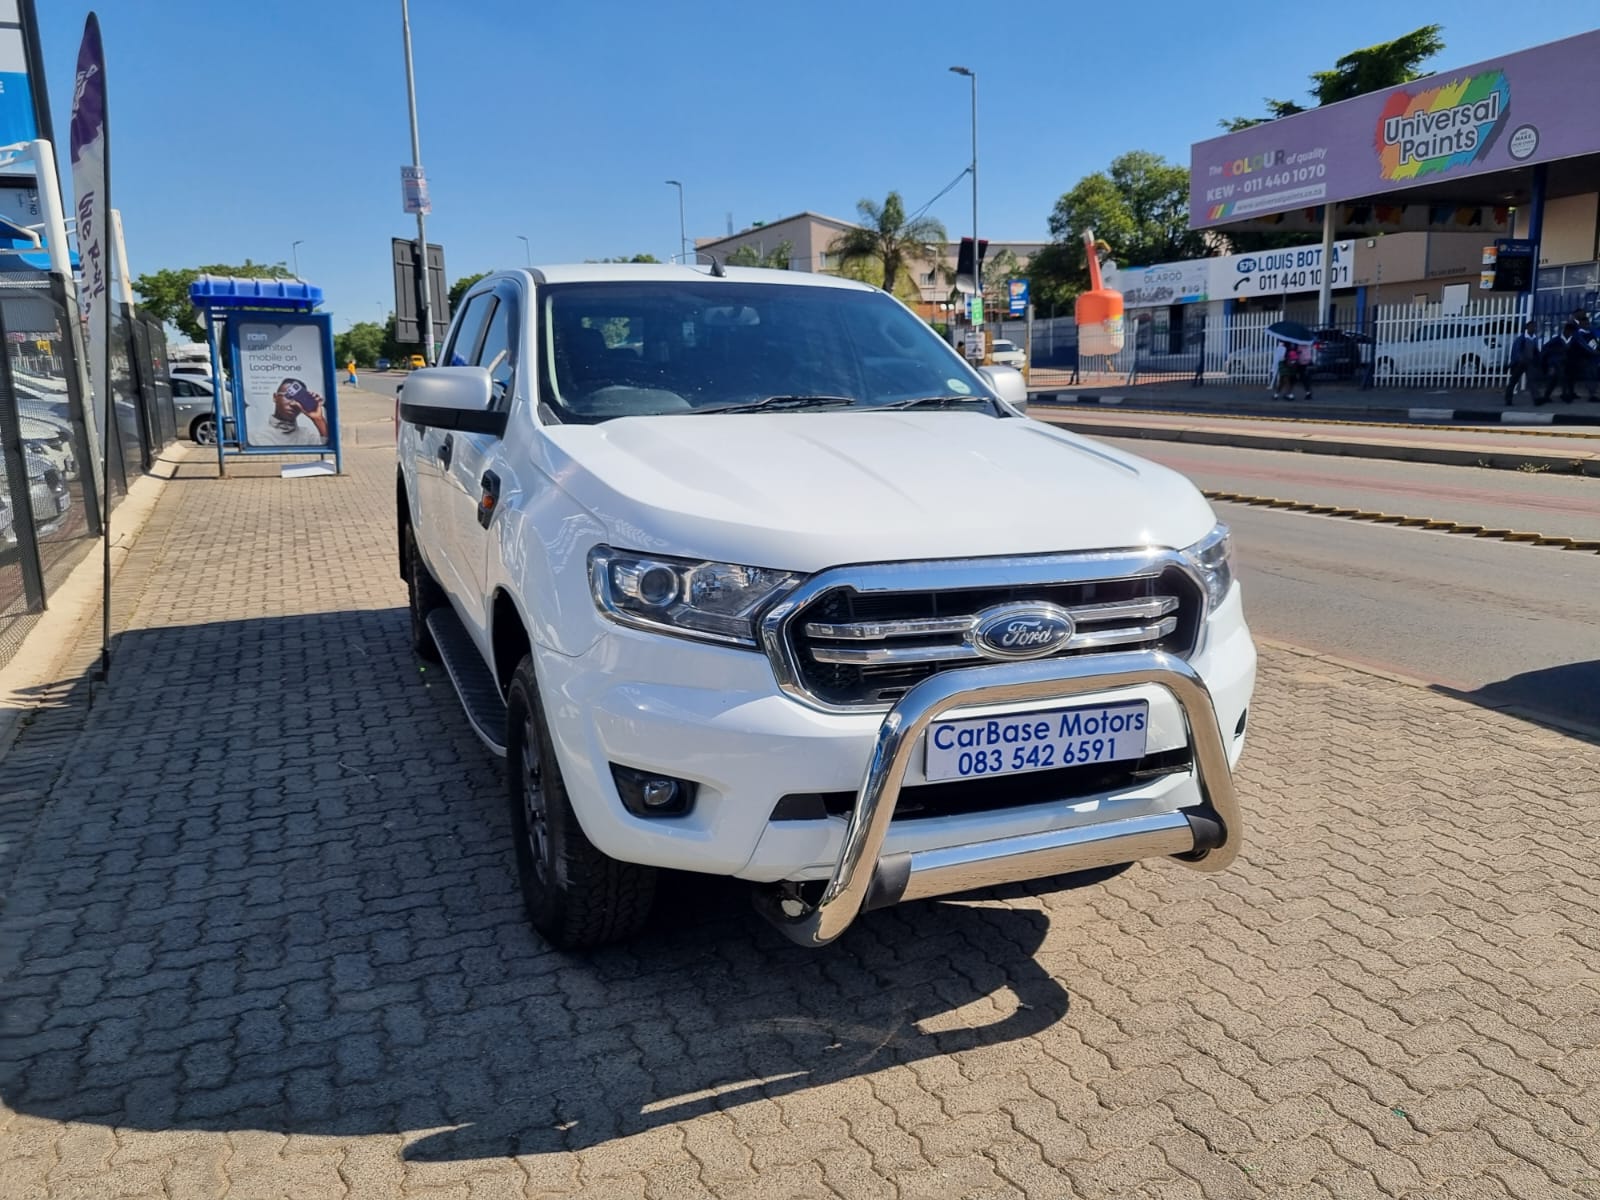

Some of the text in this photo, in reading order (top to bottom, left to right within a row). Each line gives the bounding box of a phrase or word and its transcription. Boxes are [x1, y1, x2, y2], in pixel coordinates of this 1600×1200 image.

[1385, 94, 1499, 143] Universal
[1401, 128, 1476, 163] Paints
[1223, 150, 1285, 177] COLOUR
[1286, 153, 1297, 165] of
[1297, 148, 1327, 163] quality
[1206, 184, 1235, 201] KEW
[1244, 176, 1262, 193] 011
[1265, 171, 1290, 188] 440
[1292, 163, 1326, 183] 1070
[1258, 252, 1293, 272] LOUIS
[1296, 247, 1340, 268] BOTA
[1259, 273, 1278, 291] 011
[1280, 271, 1306, 289] 440
[247, 343, 293, 352] unlimited
[248, 353, 282, 361] mobile
[249, 363, 302, 373] LoopPhone
[1002, 620, 1054, 647] Ford
[933, 710, 1145, 751] CarBase Motors
[958, 737, 1116, 775] 083 542 6591
